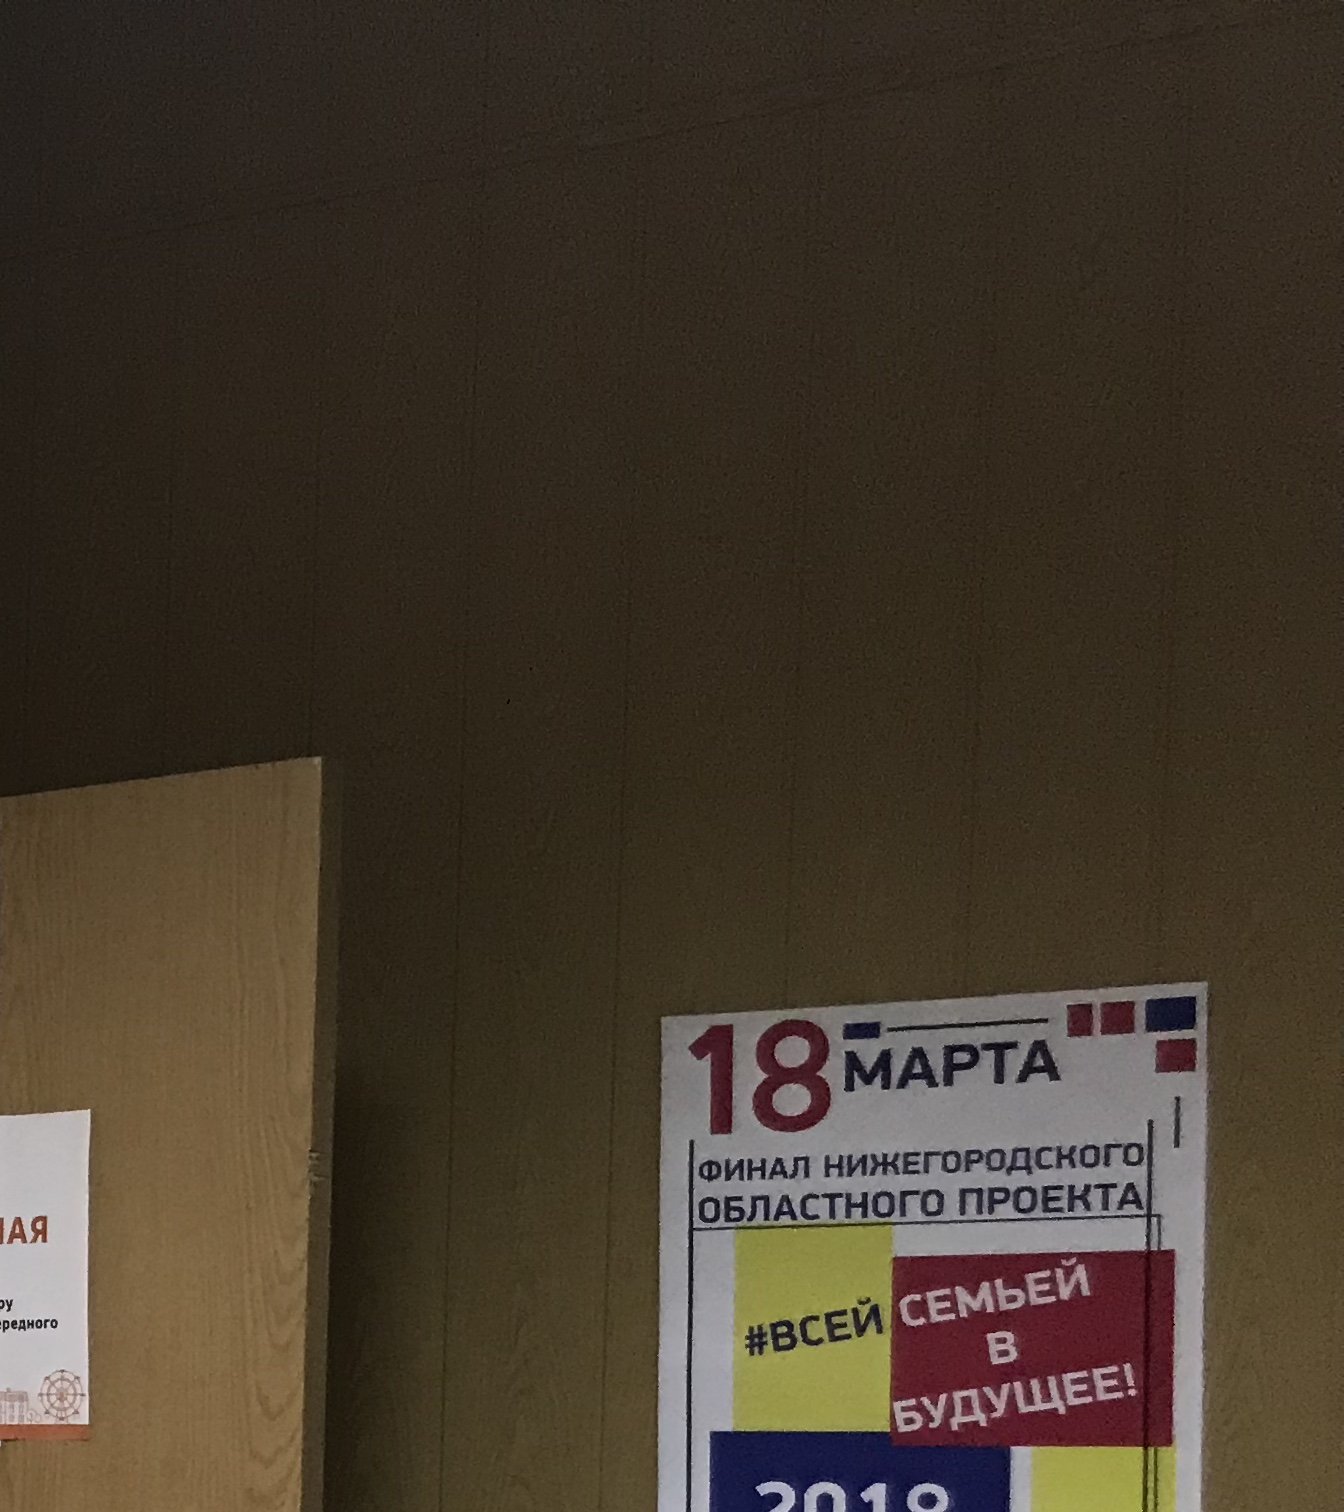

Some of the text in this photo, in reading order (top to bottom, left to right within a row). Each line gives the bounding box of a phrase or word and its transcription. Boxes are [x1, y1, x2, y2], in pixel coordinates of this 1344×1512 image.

[688, 1019, 1061, 1135] 18 МАРТА
[699, 1143, 1144, 1182] ФИНАЛ НИЖЕГОРОДСКОГО
[699, 1183, 1143, 1223] ОБЛАСТНОГО ПРОЕКТА
[745, 1258, 1091, 1357] #ВСЕЙ СЕМЬЕЙ
[987, 1332, 1018, 1365] В
[893, 1364, 1137, 1433] БУДУЩЕЕ!
